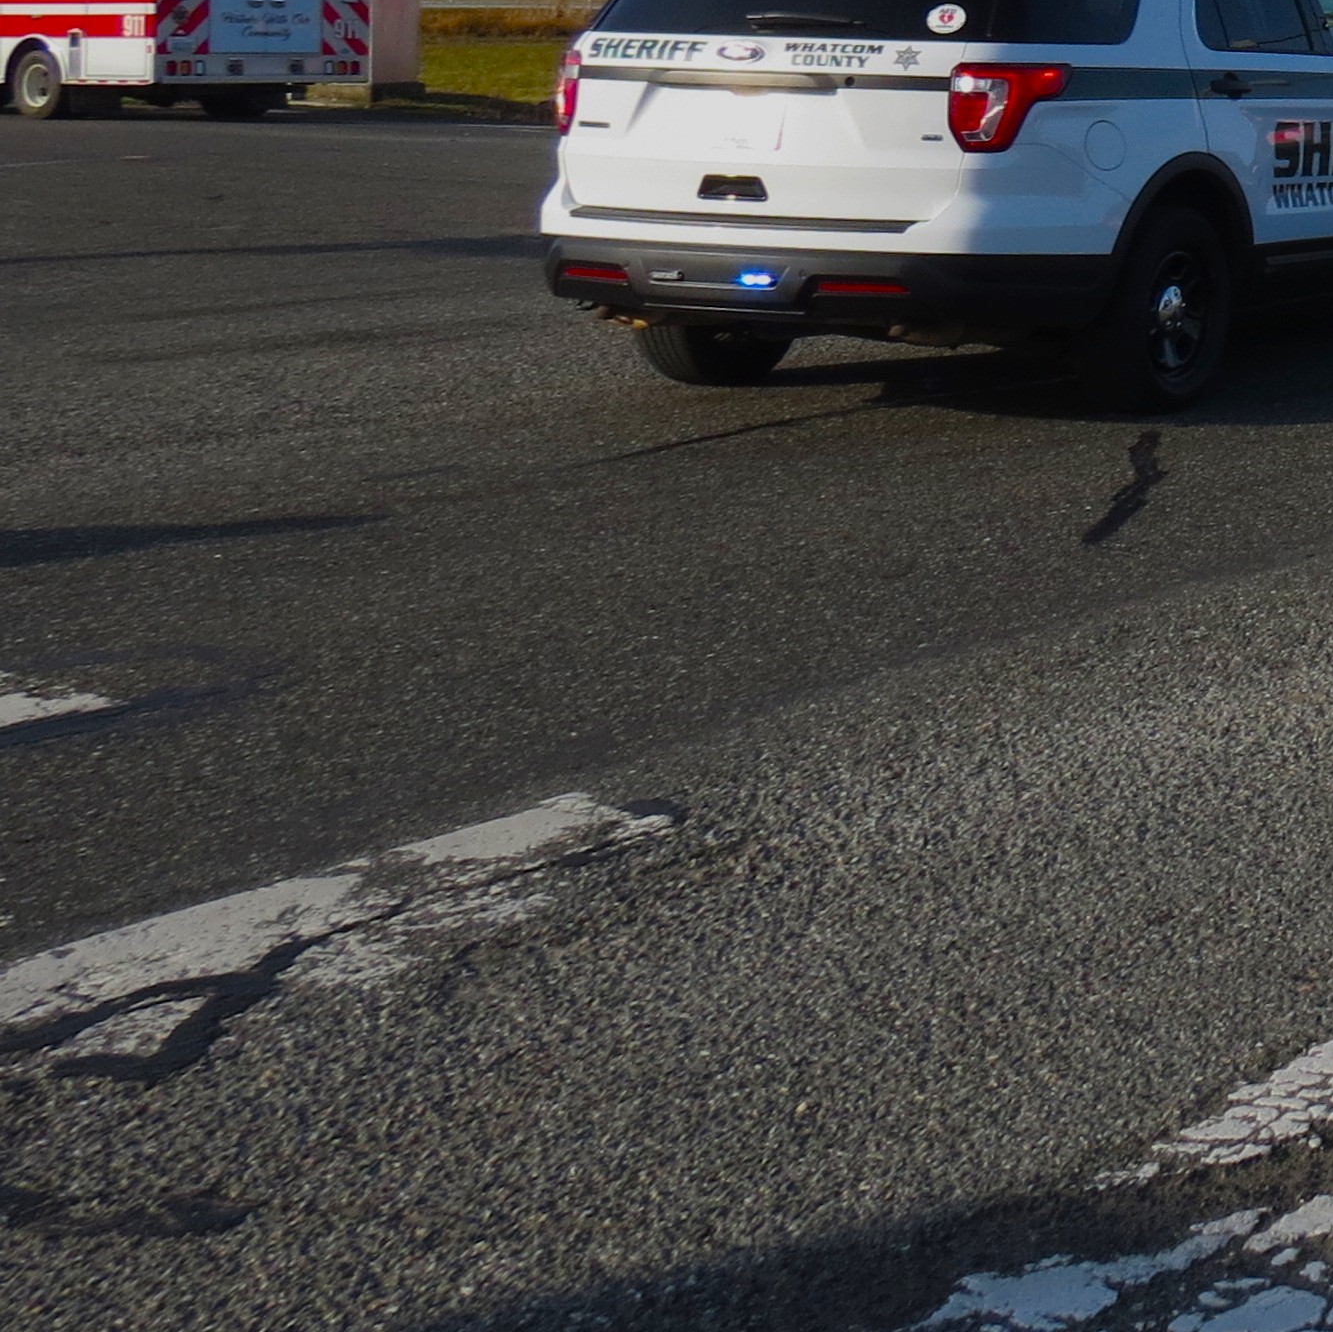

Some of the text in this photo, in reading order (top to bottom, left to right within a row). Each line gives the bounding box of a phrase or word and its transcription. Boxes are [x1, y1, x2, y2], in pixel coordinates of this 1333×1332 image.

[124, 15, 145, 36] 911
[588, 37, 709, 62] SHERIFF
[784, 42, 884, 54] WHATCOM
[791, 54, 870, 68] COUNTY
